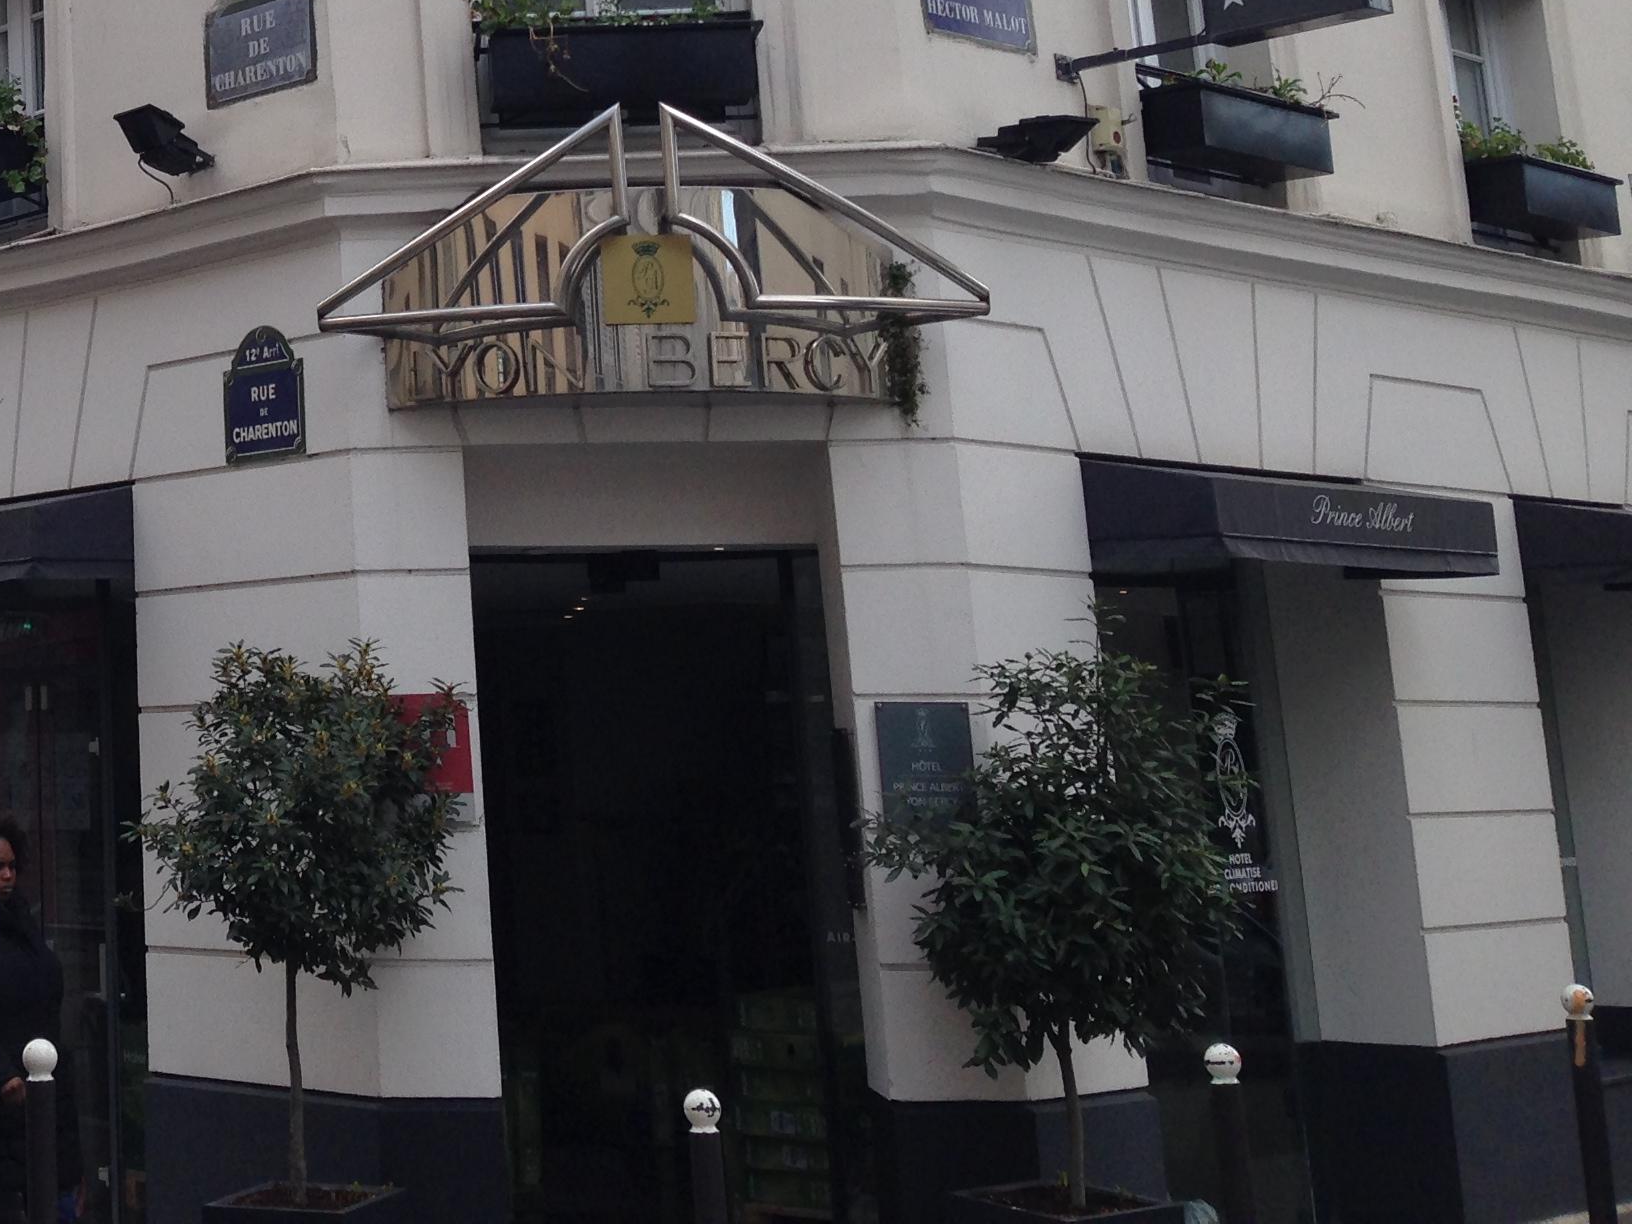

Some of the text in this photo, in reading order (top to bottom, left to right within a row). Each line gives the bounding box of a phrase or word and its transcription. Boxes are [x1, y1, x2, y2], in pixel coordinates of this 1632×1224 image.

[240, 10, 276, 37] RUE
[983, 9, 1027, 35] MALOT
[248, 37, 269, 58] DE
[214, 51, 307, 92] CHARENTON
[408, 332, 889, 404] LYON BERCY
[251, 384, 276, 402] RUE
[260, 408, 268, 416] DE
[233, 420, 297, 443] CHARENTON
[1311, 495, 1414, 532] Prince Albert
[1229, 852, 1253, 865] HOTEL
